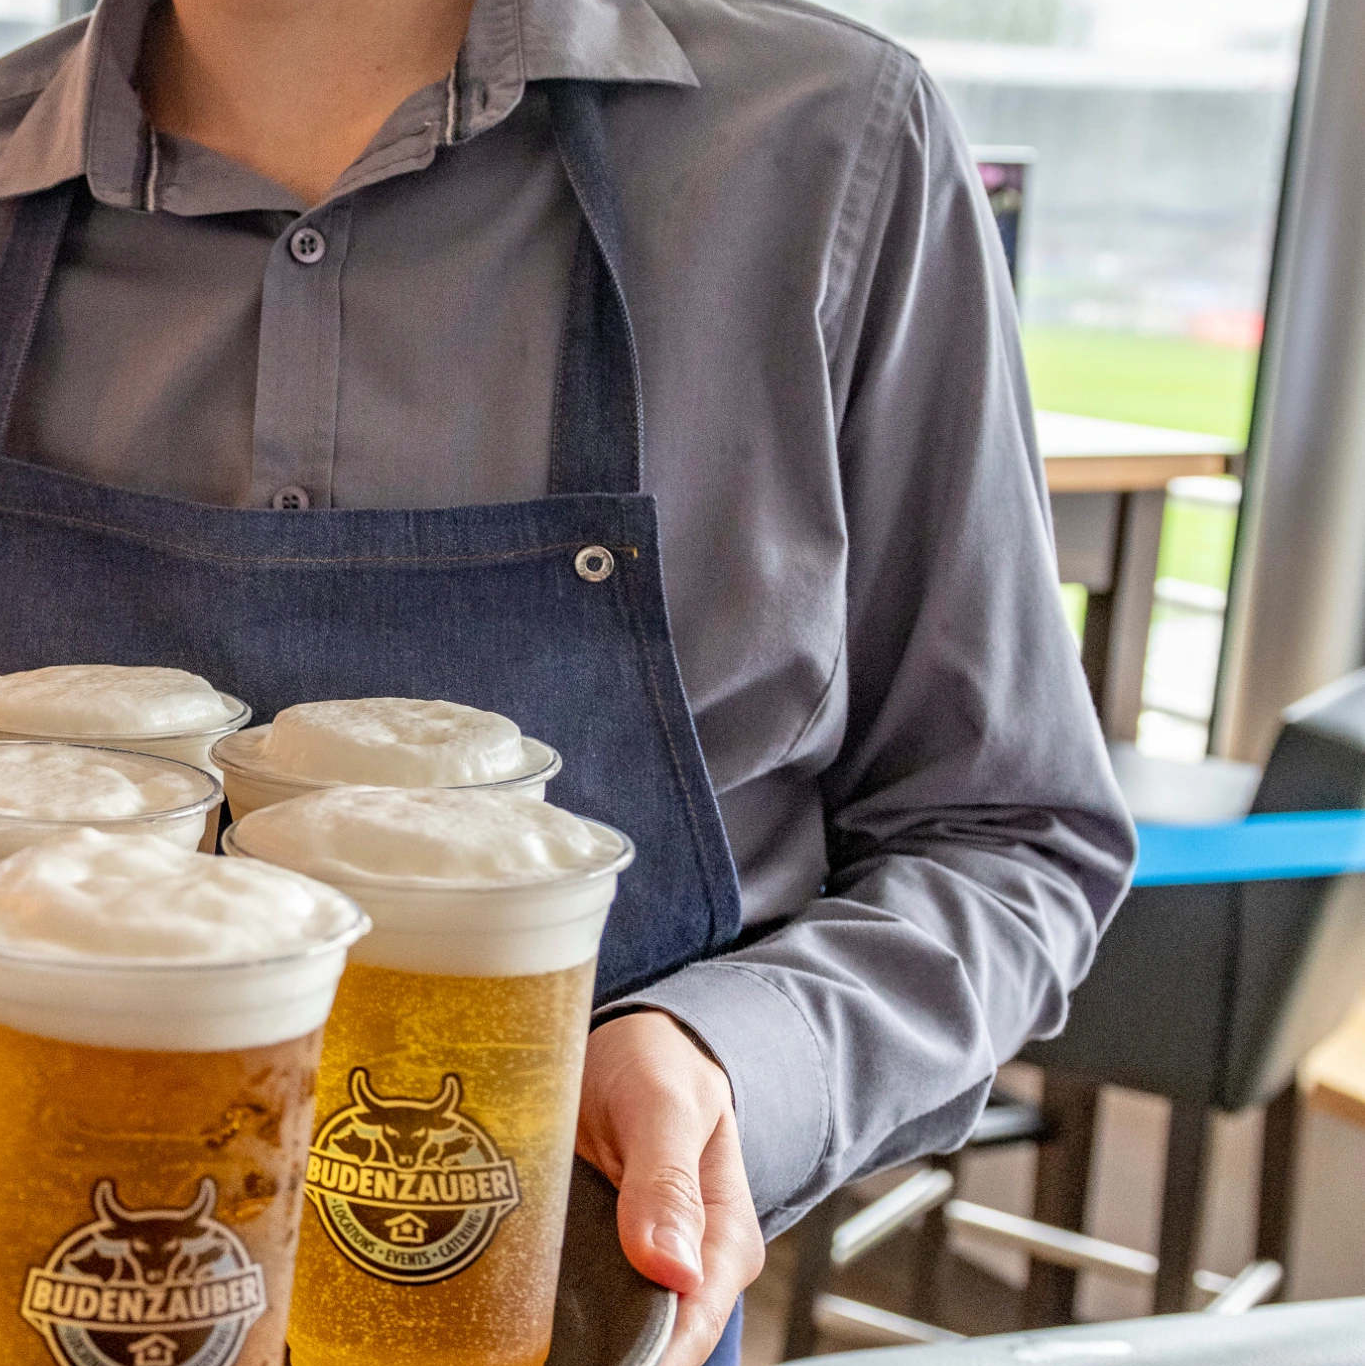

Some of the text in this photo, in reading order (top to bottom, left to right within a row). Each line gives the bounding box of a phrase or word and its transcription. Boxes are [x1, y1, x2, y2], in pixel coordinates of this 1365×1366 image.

[305, 1154, 511, 1204] BUDENZAUBER
[384, 1248, 432, 1267] EVENTS
[437, 1211, 484, 1259] CATERING
[31, 1277, 259, 1323] BUDENZAUBER
